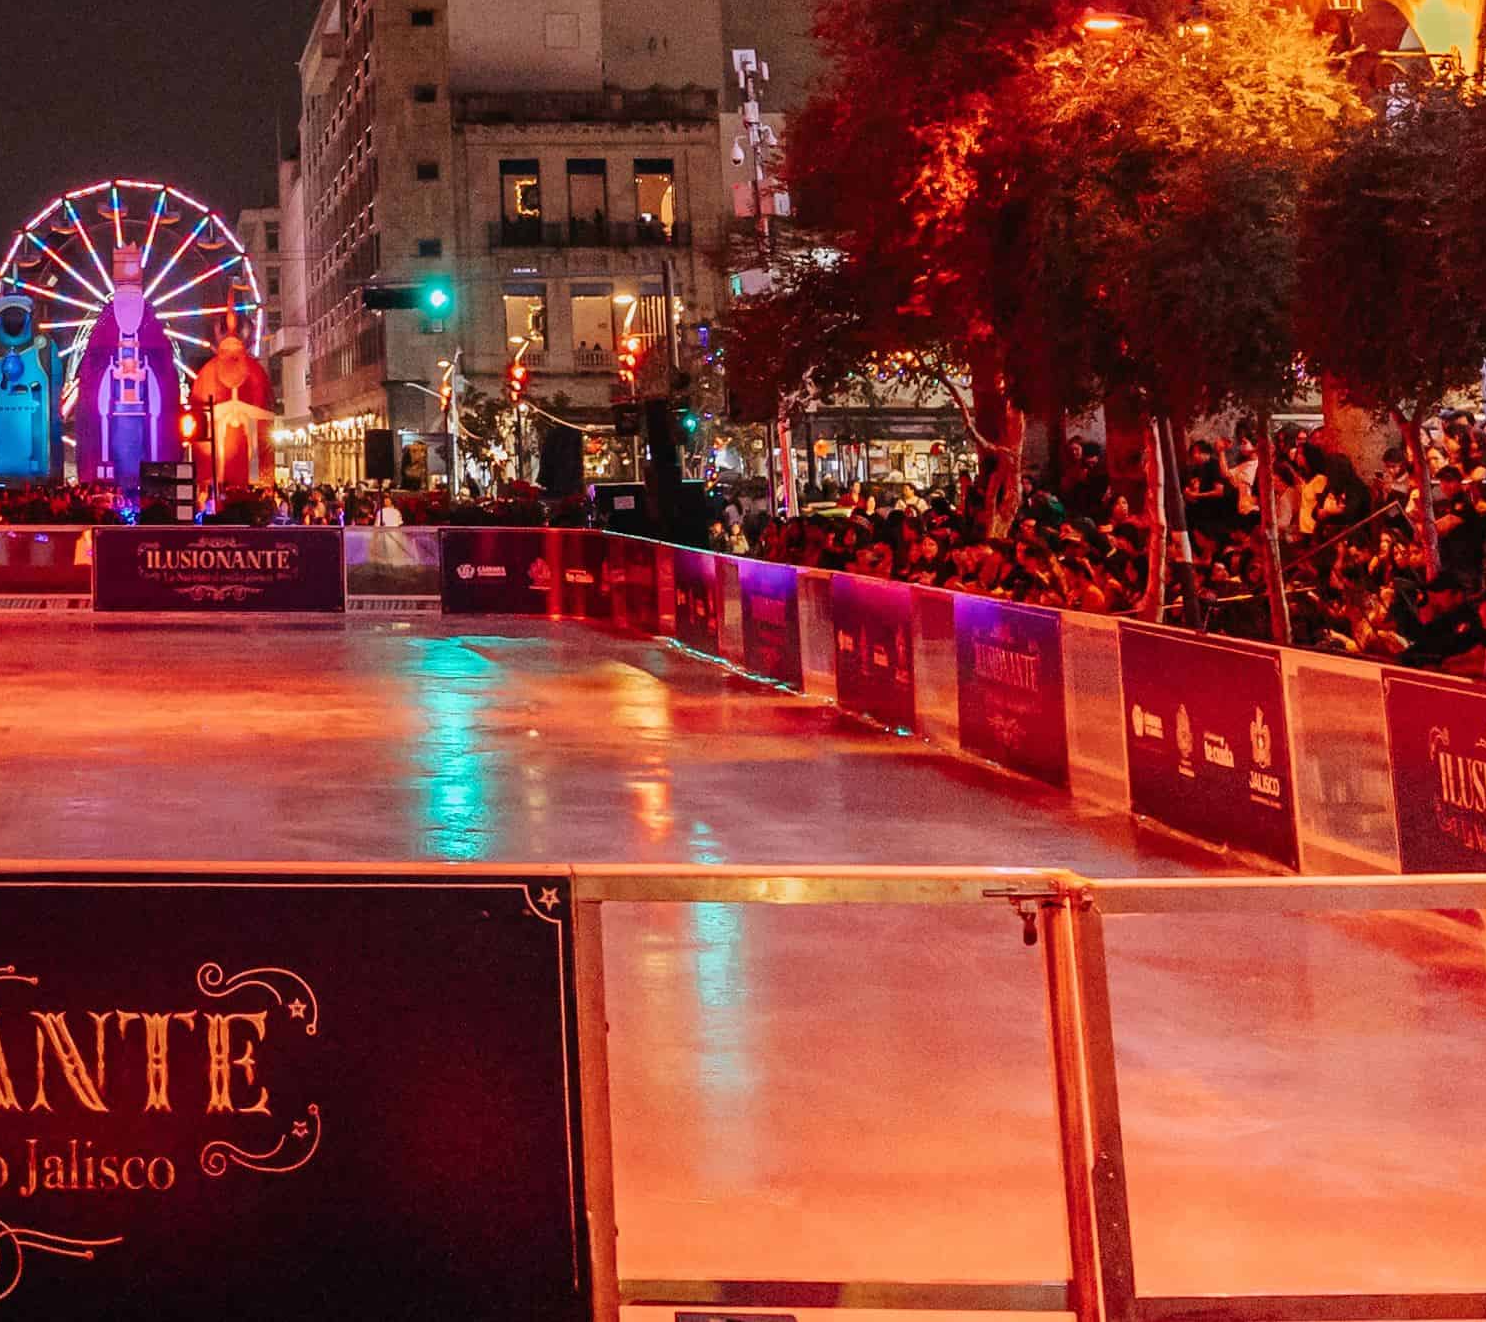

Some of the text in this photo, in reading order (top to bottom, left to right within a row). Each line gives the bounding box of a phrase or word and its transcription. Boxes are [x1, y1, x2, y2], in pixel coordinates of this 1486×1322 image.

[147, 550, 290, 569] ILUSIONANTE
[1249, 770, 1280, 797] JALISCO
[20, 1138, 175, 1197] Jalisco
